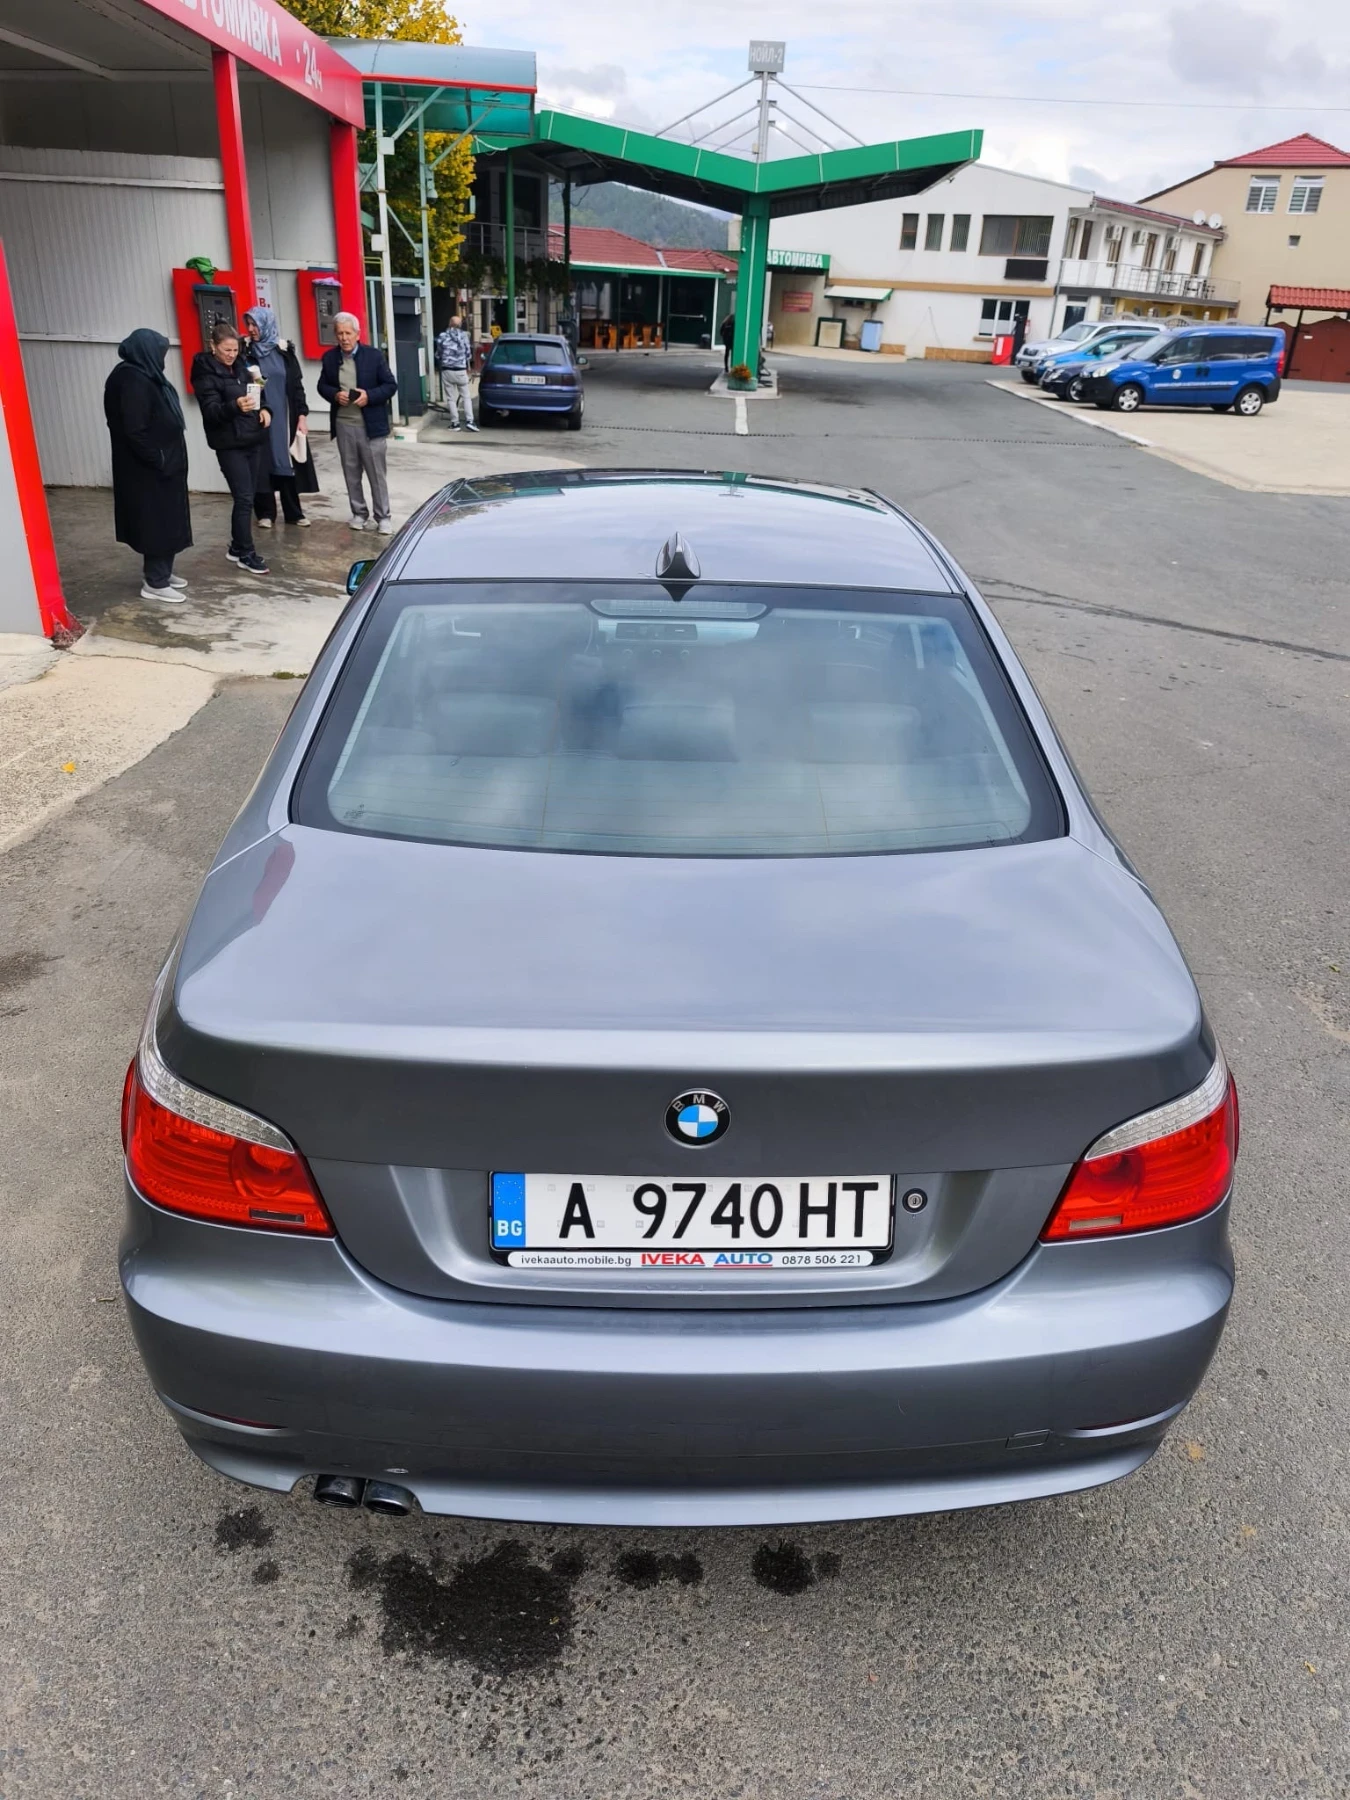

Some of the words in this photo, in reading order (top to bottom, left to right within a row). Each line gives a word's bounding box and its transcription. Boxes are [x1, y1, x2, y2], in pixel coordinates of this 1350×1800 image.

[767, 250, 823, 268] АВТОМИВКА
[672, 1094, 726, 1113] BMW
[558, 1182, 596, 1239] A
[632, 1182, 784, 1239] 9740
[799, 1181, 879, 1238] HT
[497, 1219, 523, 1236] BG
[521, 1255, 632, 1267] ivekaauto.mobile.bg
[641, 1253, 705, 1265] IVEKA
[715, 1252, 773, 1265] AUTO
[782, 1255, 811, 1265] 0878
[815, 1254, 837, 1264] 506
[840, 1254, 861, 1264] 221
